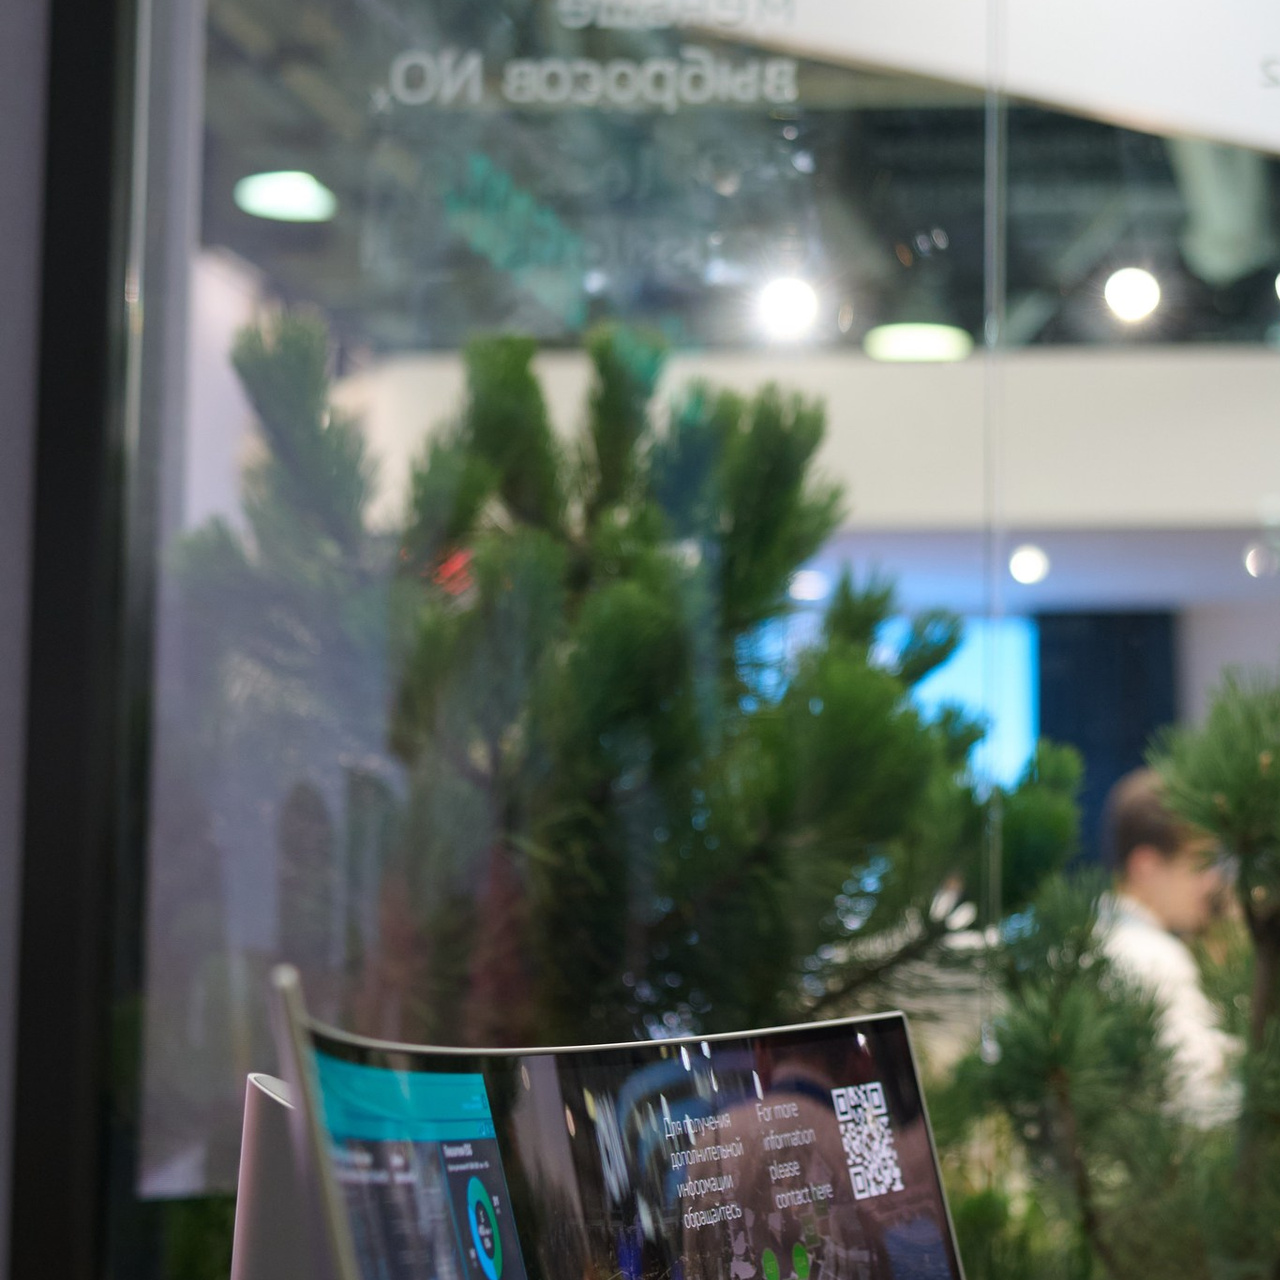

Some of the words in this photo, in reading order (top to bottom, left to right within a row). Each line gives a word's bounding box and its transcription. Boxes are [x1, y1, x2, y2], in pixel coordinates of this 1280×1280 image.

[755, 1103, 773, 1122] For
[773, 1102, 799, 1120] more
[663, 1117, 683, 1140] Для
[682, 1113, 732, 1137] получения
[762, 1125, 817, 1151] information
[670, 1137, 745, 1171] дополнительной
[769, 1160, 801, 1184] please
[676, 1175, 734, 1199] информации
[775, 1186, 812, 1209] contact
[809, 1181, 834, 1201] here
[683, 1202, 743, 1231] обращайтесь
